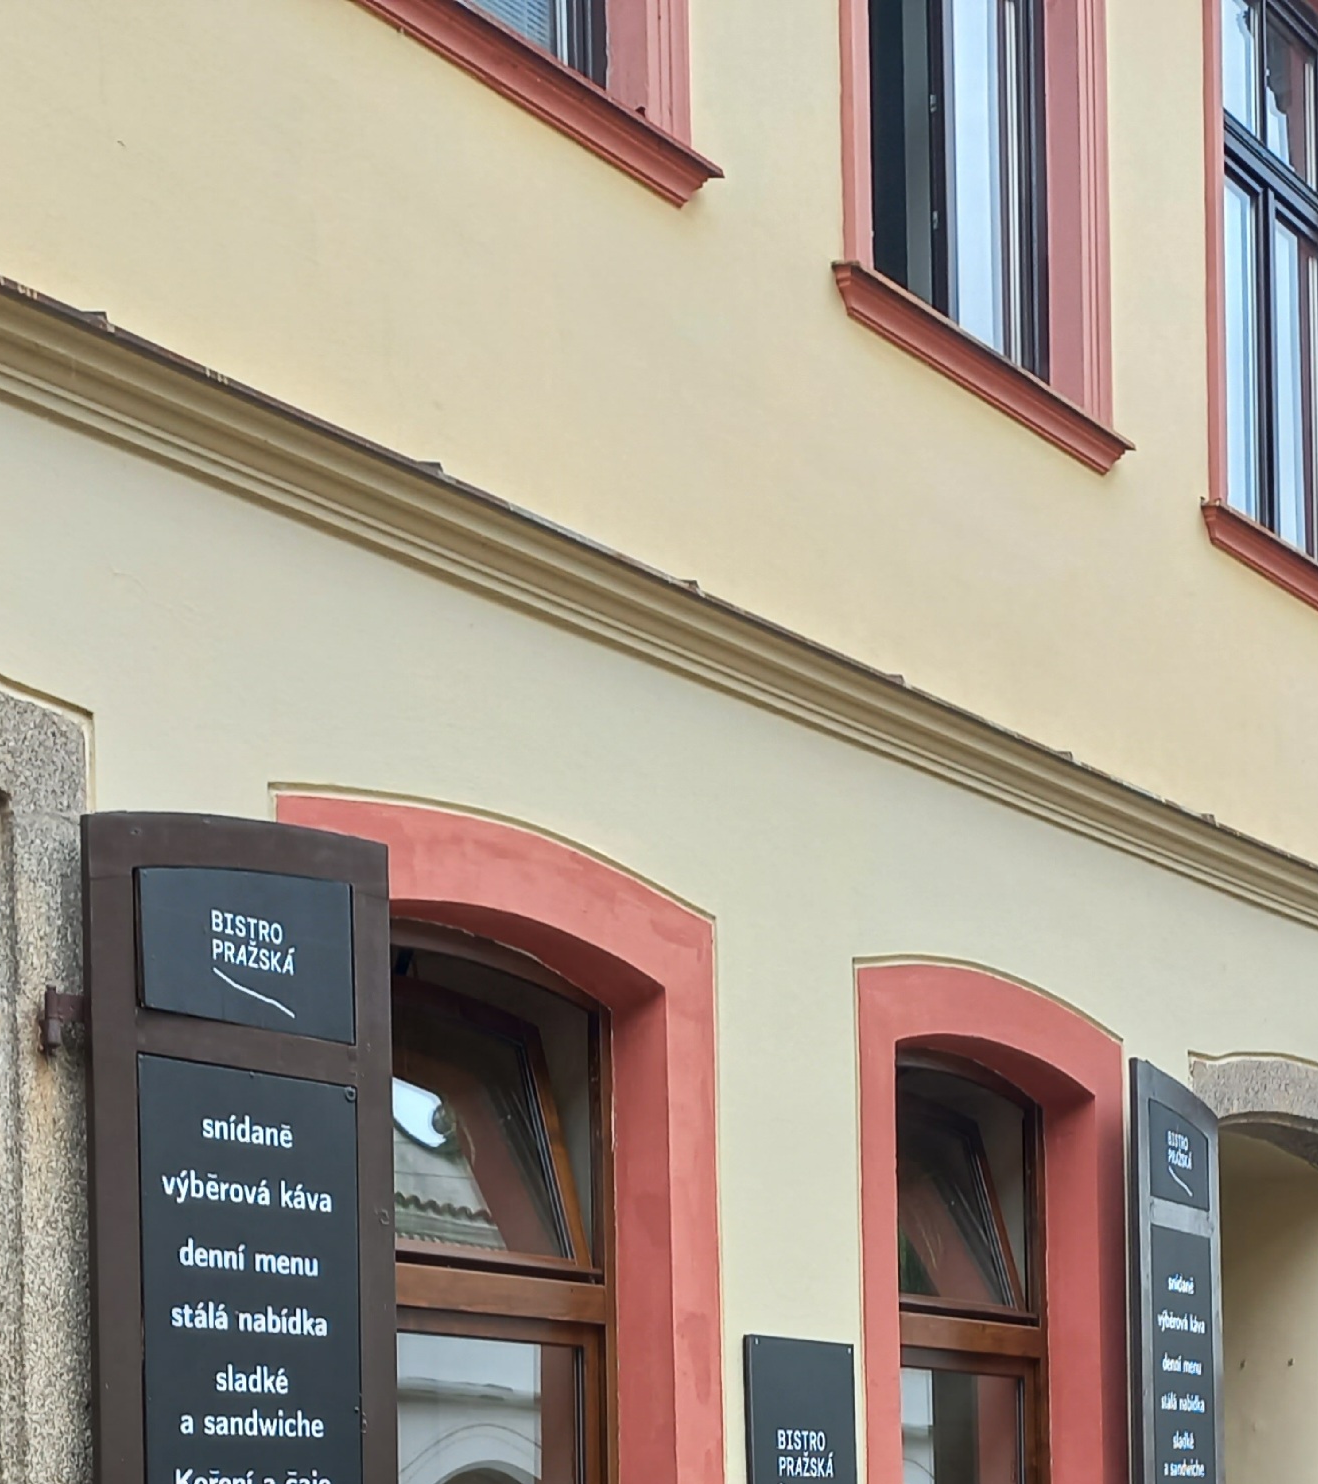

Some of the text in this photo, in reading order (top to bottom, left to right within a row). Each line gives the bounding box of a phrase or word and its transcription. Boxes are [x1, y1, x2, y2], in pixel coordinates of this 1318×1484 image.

[210, 908, 283, 946] BISTRO
[211, 938, 295, 977] PRAŽSKÁ
[280, 1179, 332, 1214] káva
[179, 1237, 319, 1277] denní menu
[171, 1301, 328, 1337] stálá nabídka
[215, 1364, 289, 1395] sladké
[180, 1409, 324, 1438] a sandwiche
[777, 1428, 826, 1451] BISTRO
[778, 1451, 834, 1478] PRAŽSKÁ
